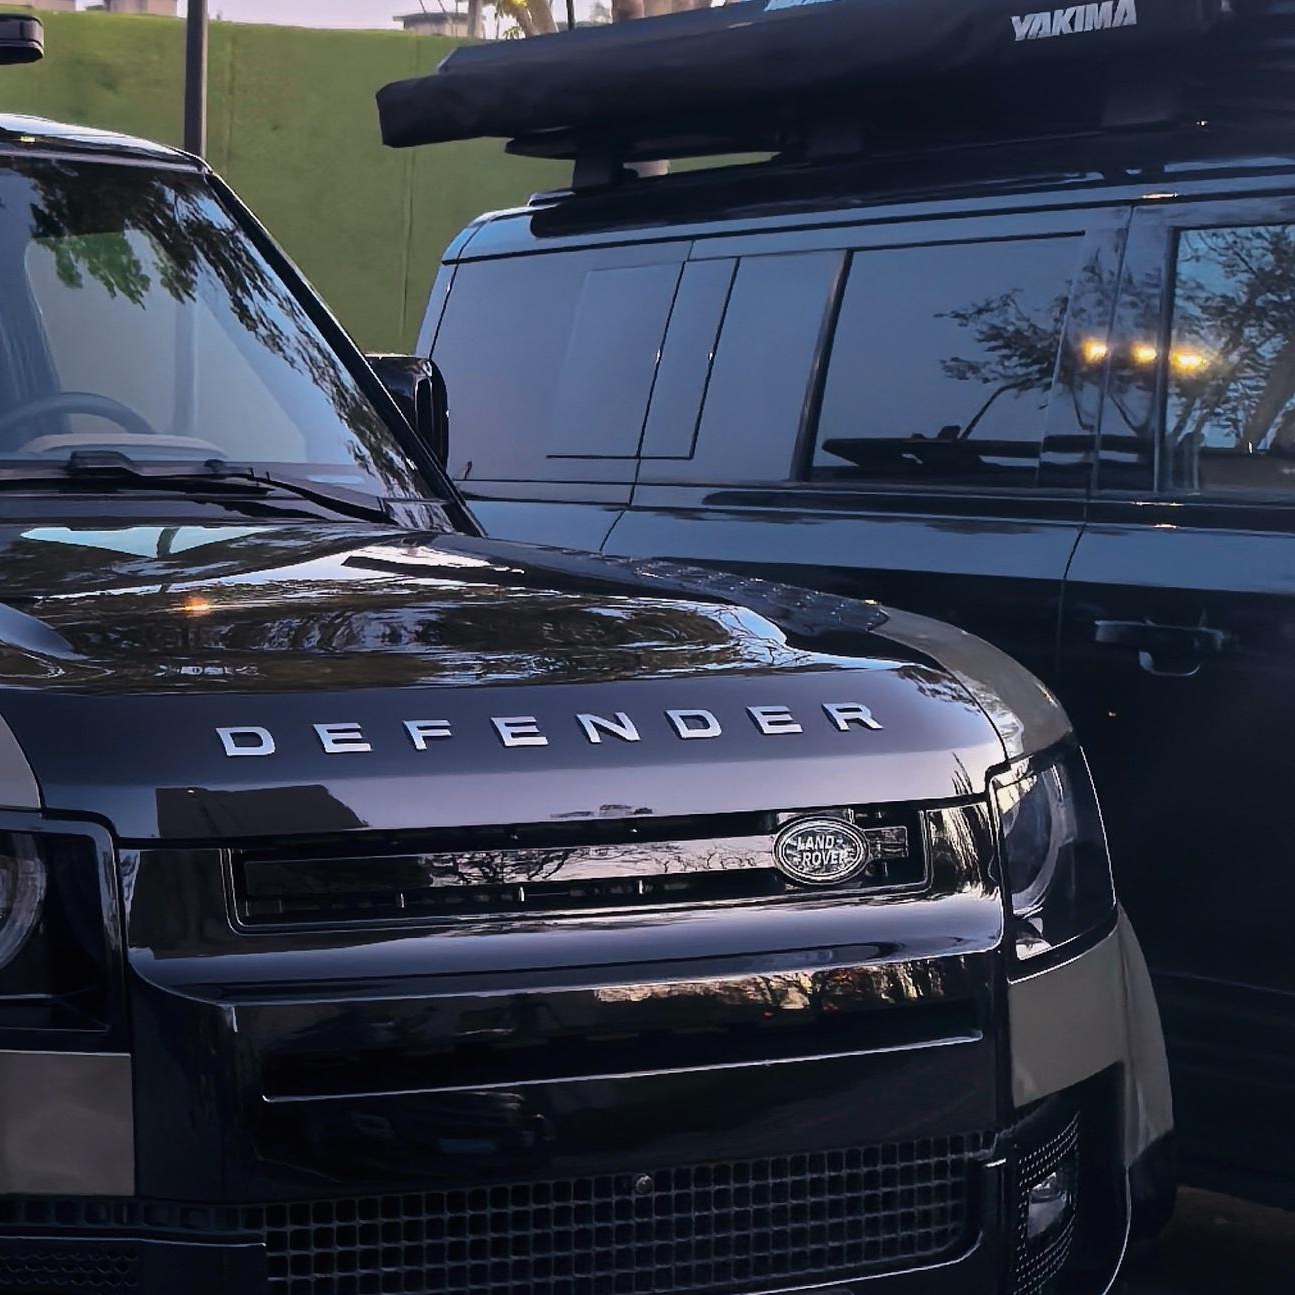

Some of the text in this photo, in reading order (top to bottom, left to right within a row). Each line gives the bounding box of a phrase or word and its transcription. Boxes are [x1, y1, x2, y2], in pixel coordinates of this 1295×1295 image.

[1011, 0, 1137, 41] YAKIMA
[216, 702, 883, 757] DEFENDER
[797, 834, 835, 850] LAND
[802, 848, 849, 864] ROVER
